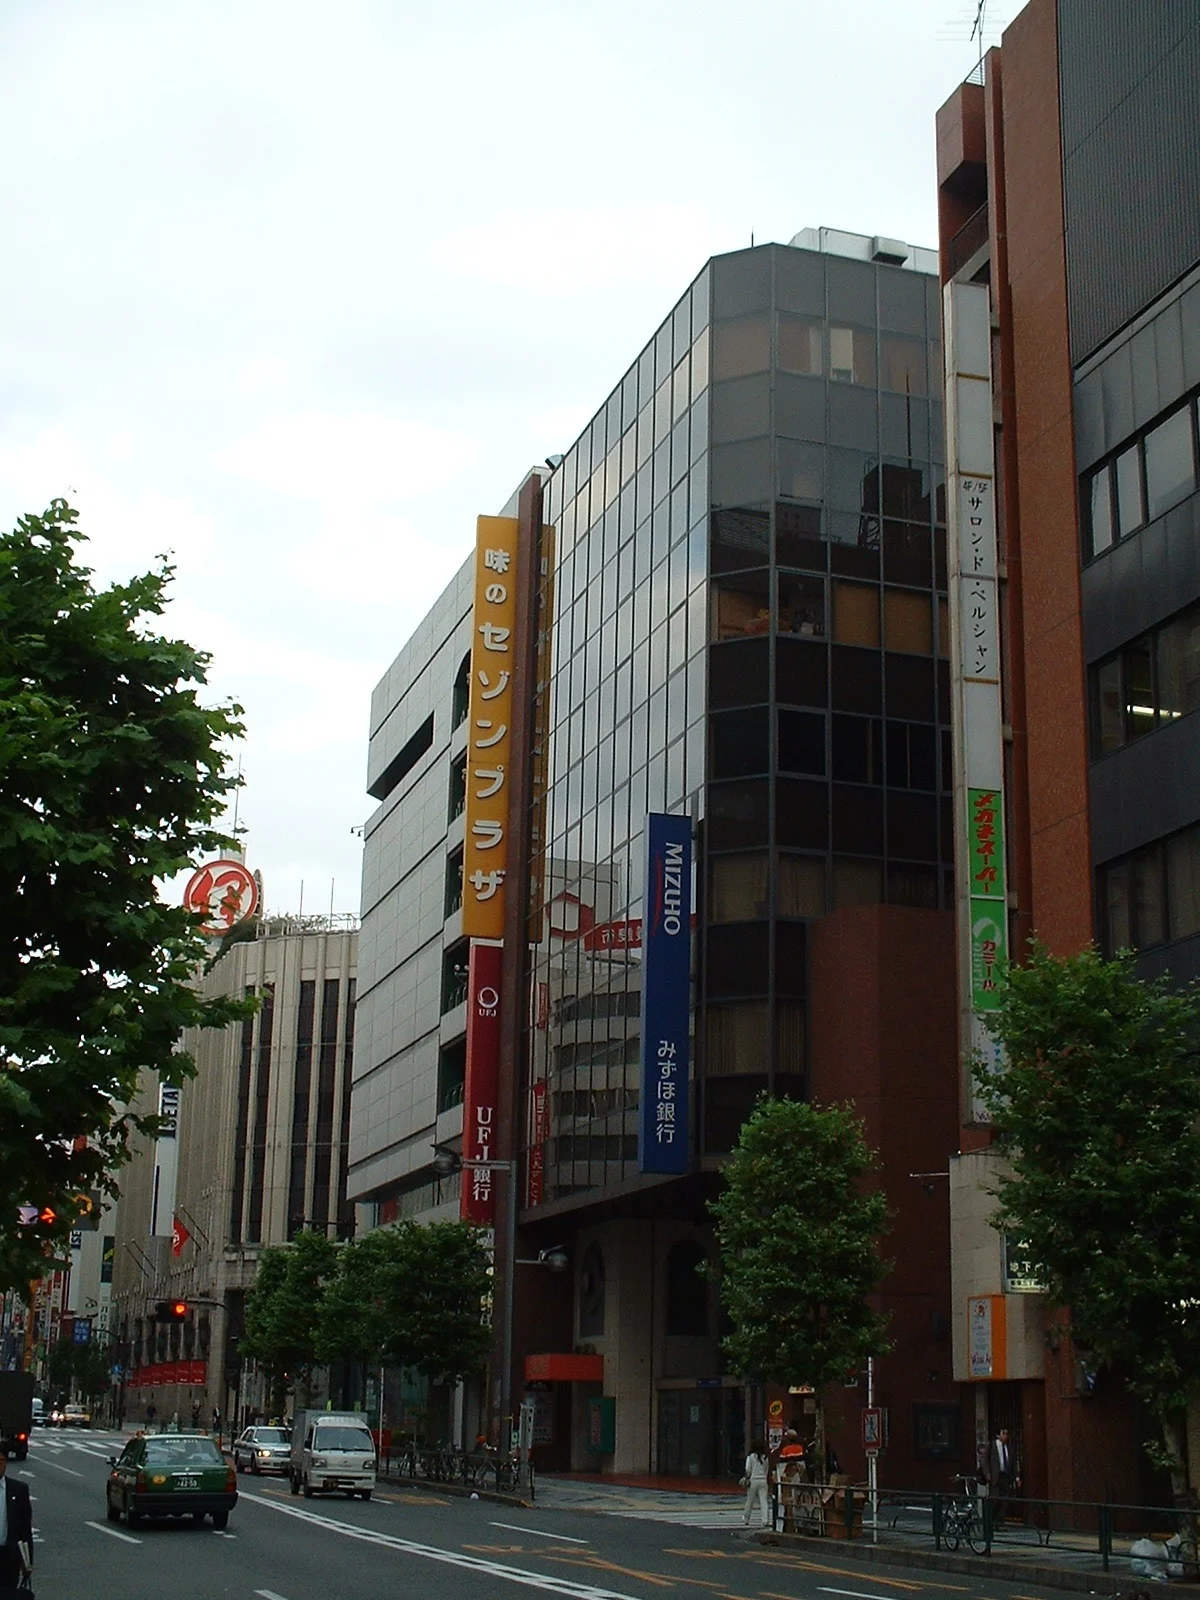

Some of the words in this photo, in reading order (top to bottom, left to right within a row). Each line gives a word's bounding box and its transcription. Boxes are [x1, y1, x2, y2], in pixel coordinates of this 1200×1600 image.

[468, 548, 511, 901] 味のセゾンプラザ
[663, 842, 684, 936] MIZUHO
[478, 1008, 497, 1017] UFJ
[655, 1040, 677, 1144] みずほ銀行
